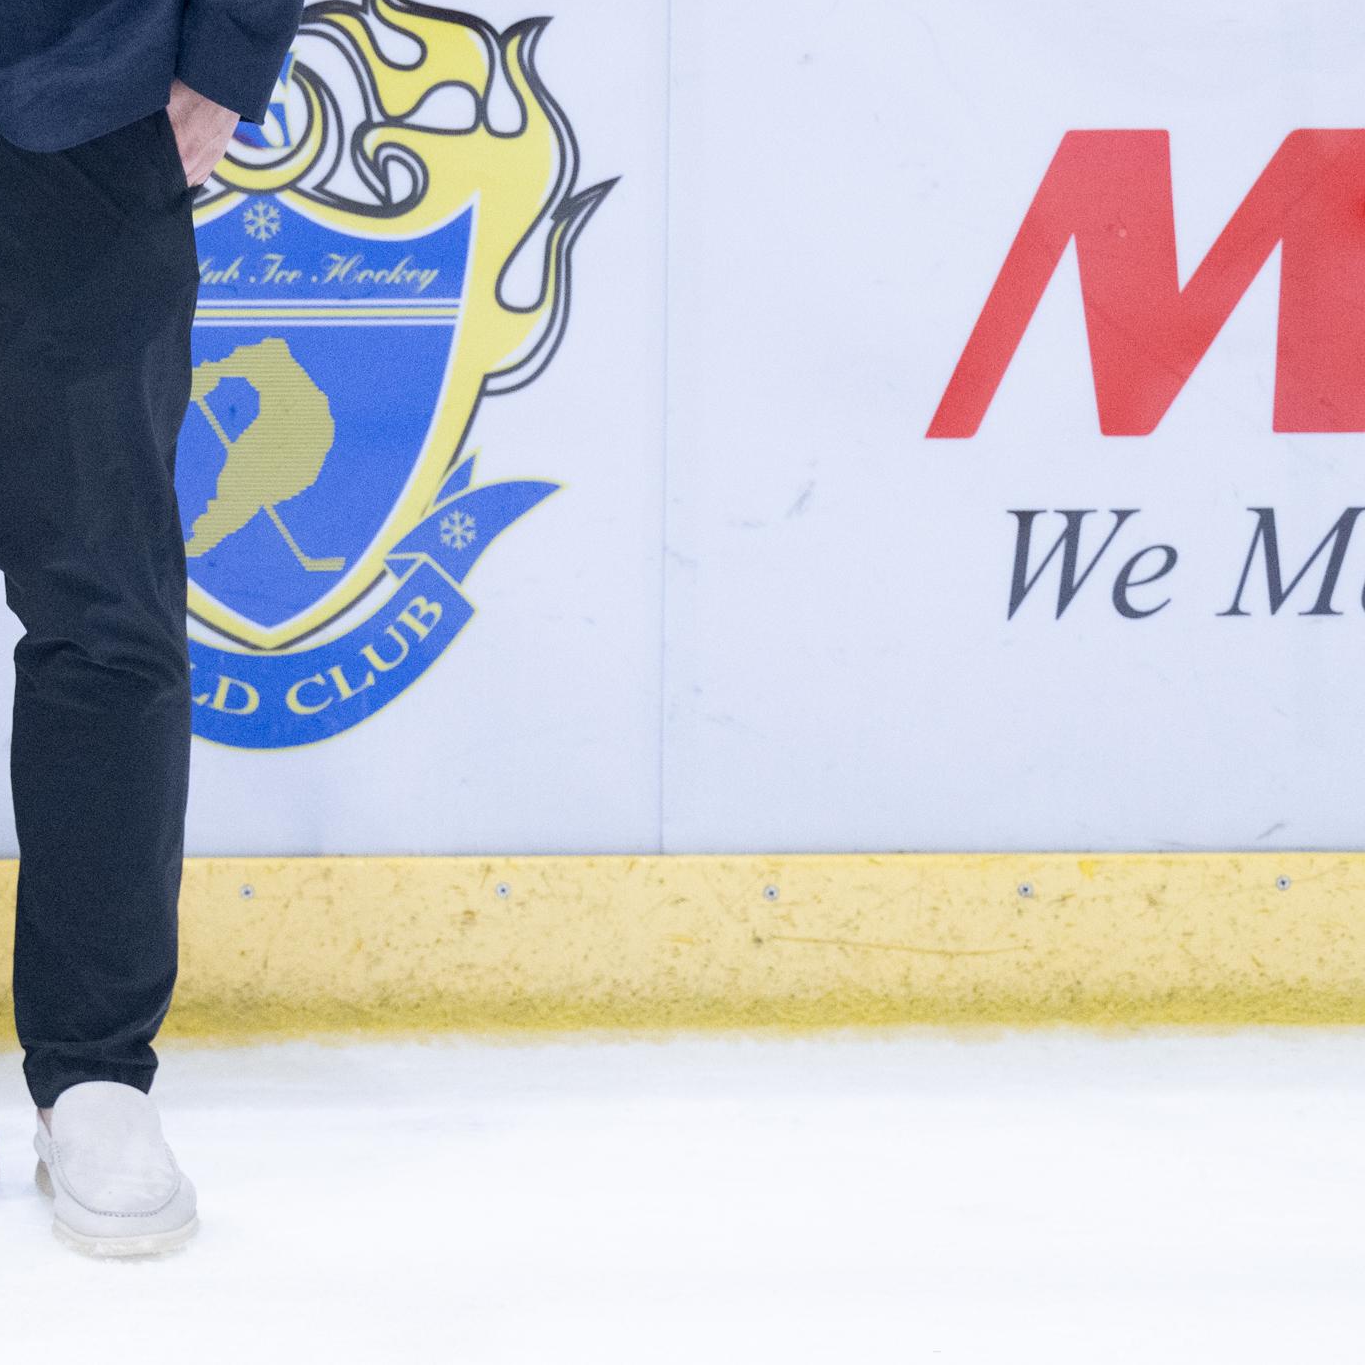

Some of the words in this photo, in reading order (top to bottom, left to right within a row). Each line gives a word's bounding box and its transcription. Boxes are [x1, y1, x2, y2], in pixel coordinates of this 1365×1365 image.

[311, 253, 439, 294] Hockey
[1006, 508, 1179, 621] We
[1215, 506, 1365, 618] M
[285, 594, 444, 716] CLUB
